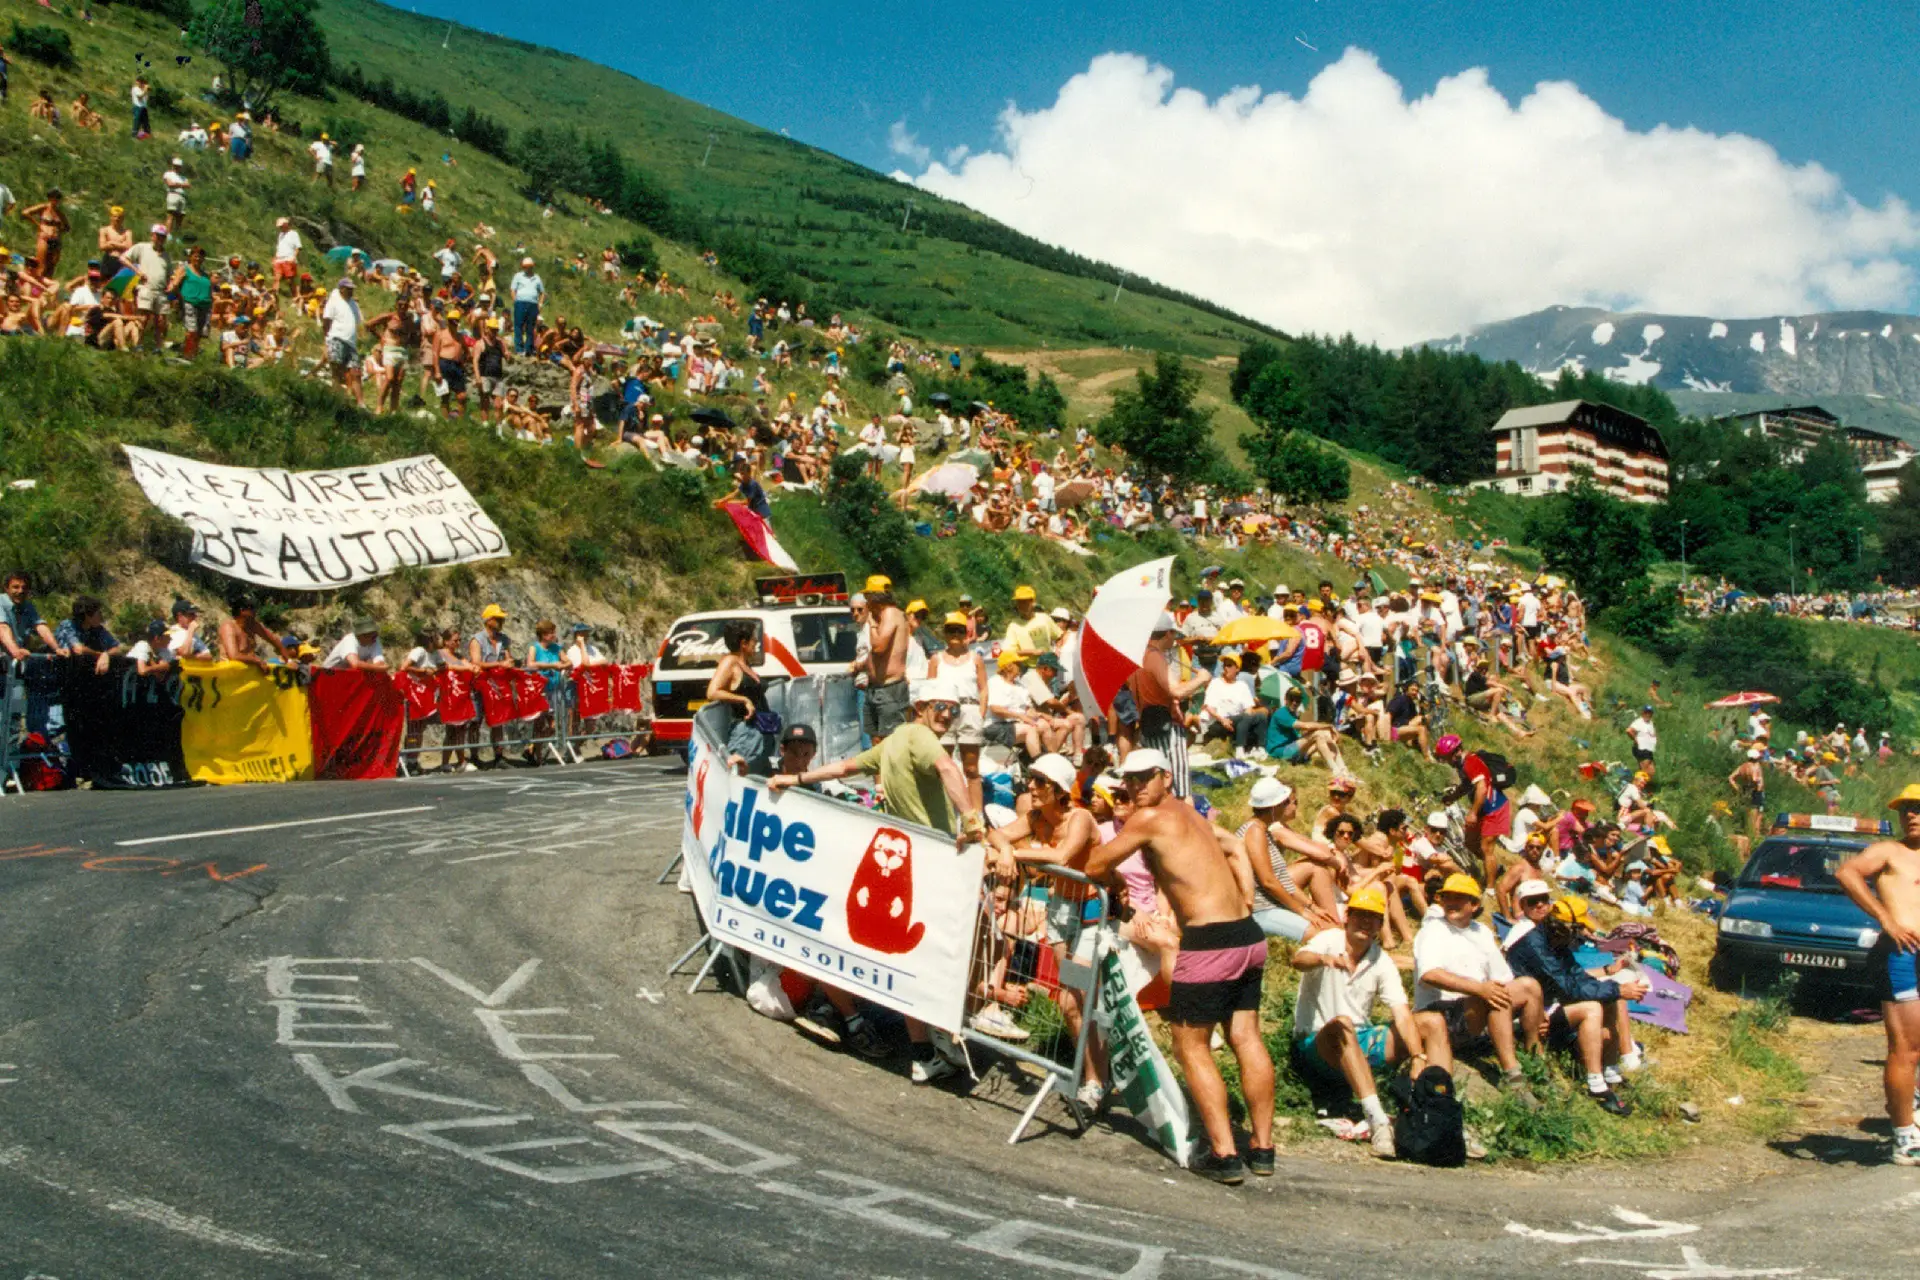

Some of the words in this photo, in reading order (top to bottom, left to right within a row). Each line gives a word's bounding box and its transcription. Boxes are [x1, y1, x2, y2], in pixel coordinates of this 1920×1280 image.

[258, 458, 457, 504] VIRENQUE
[181, 511, 503, 581] BEAUJOLAIS
[1305, 627, 1319, 649] 8
[753, 928, 786, 949] au
[800, 945, 894, 991] soleil
